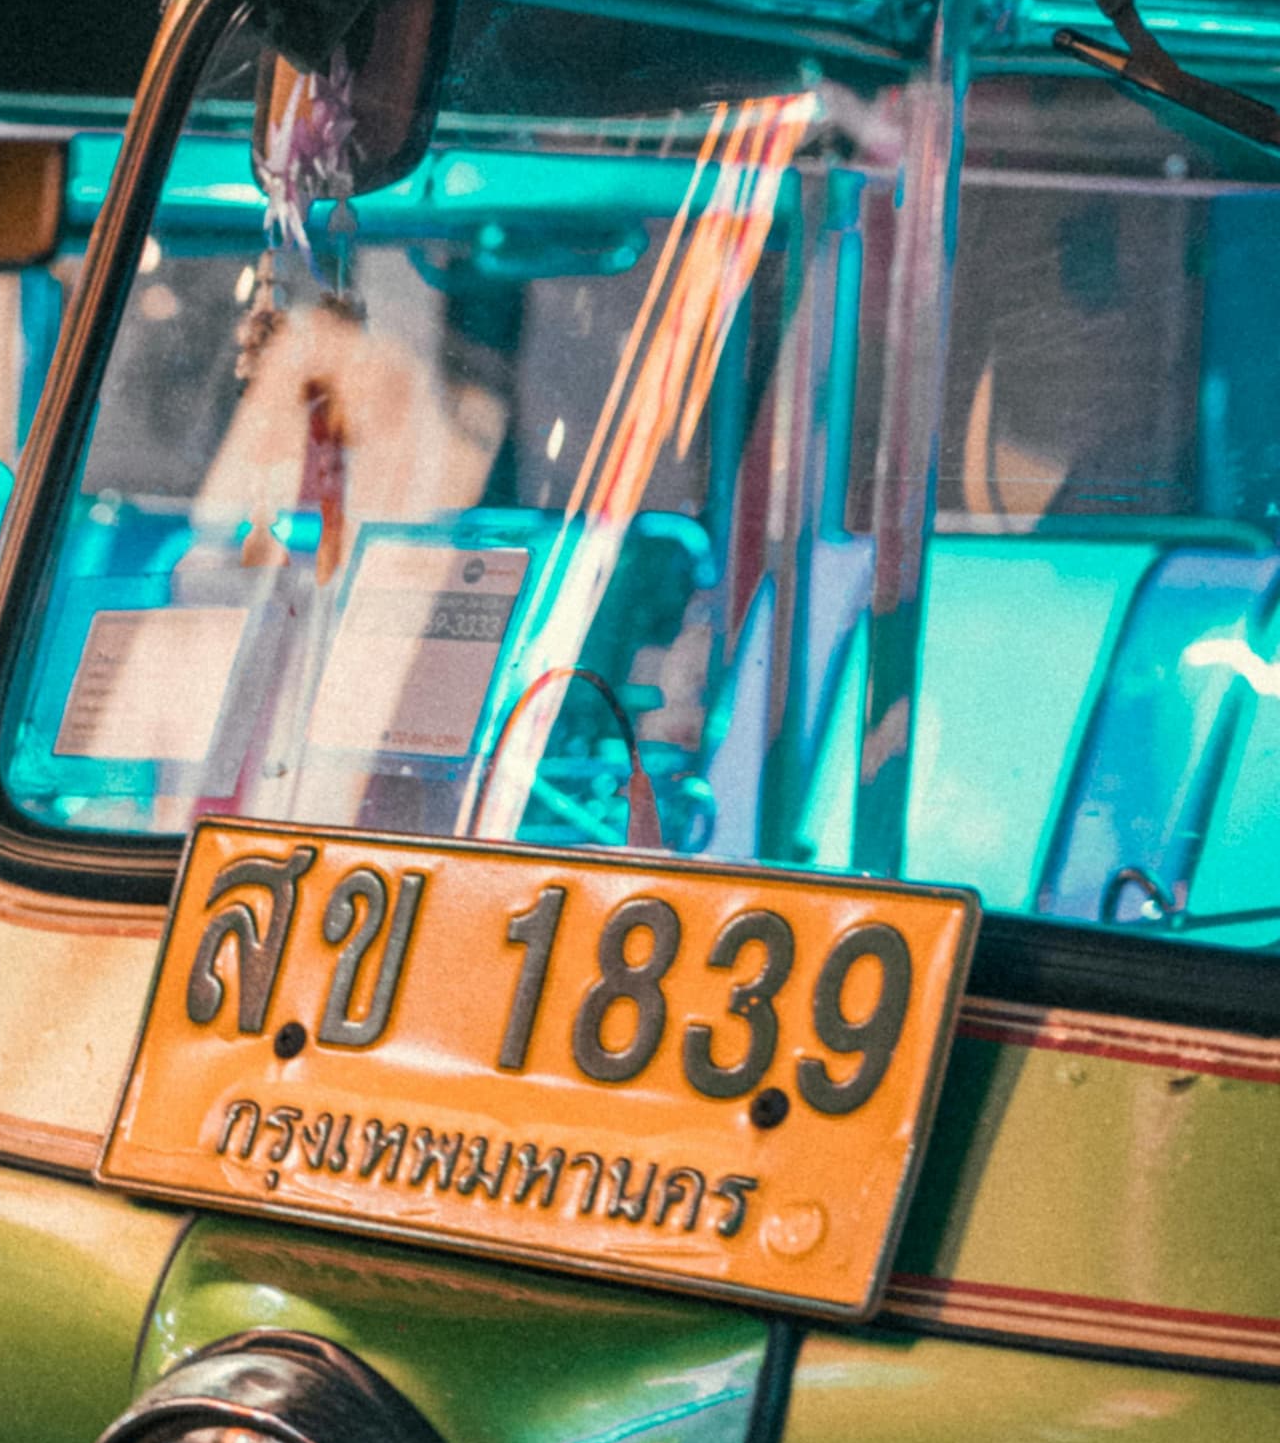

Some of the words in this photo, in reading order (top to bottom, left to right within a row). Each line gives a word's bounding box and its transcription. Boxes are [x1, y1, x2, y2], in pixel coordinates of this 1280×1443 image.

[186, 845, 426, 1047] สข
[496, 885, 913, 1116] 1839
[216, 1098, 759, 1238] กรุงเทพมหานคร
